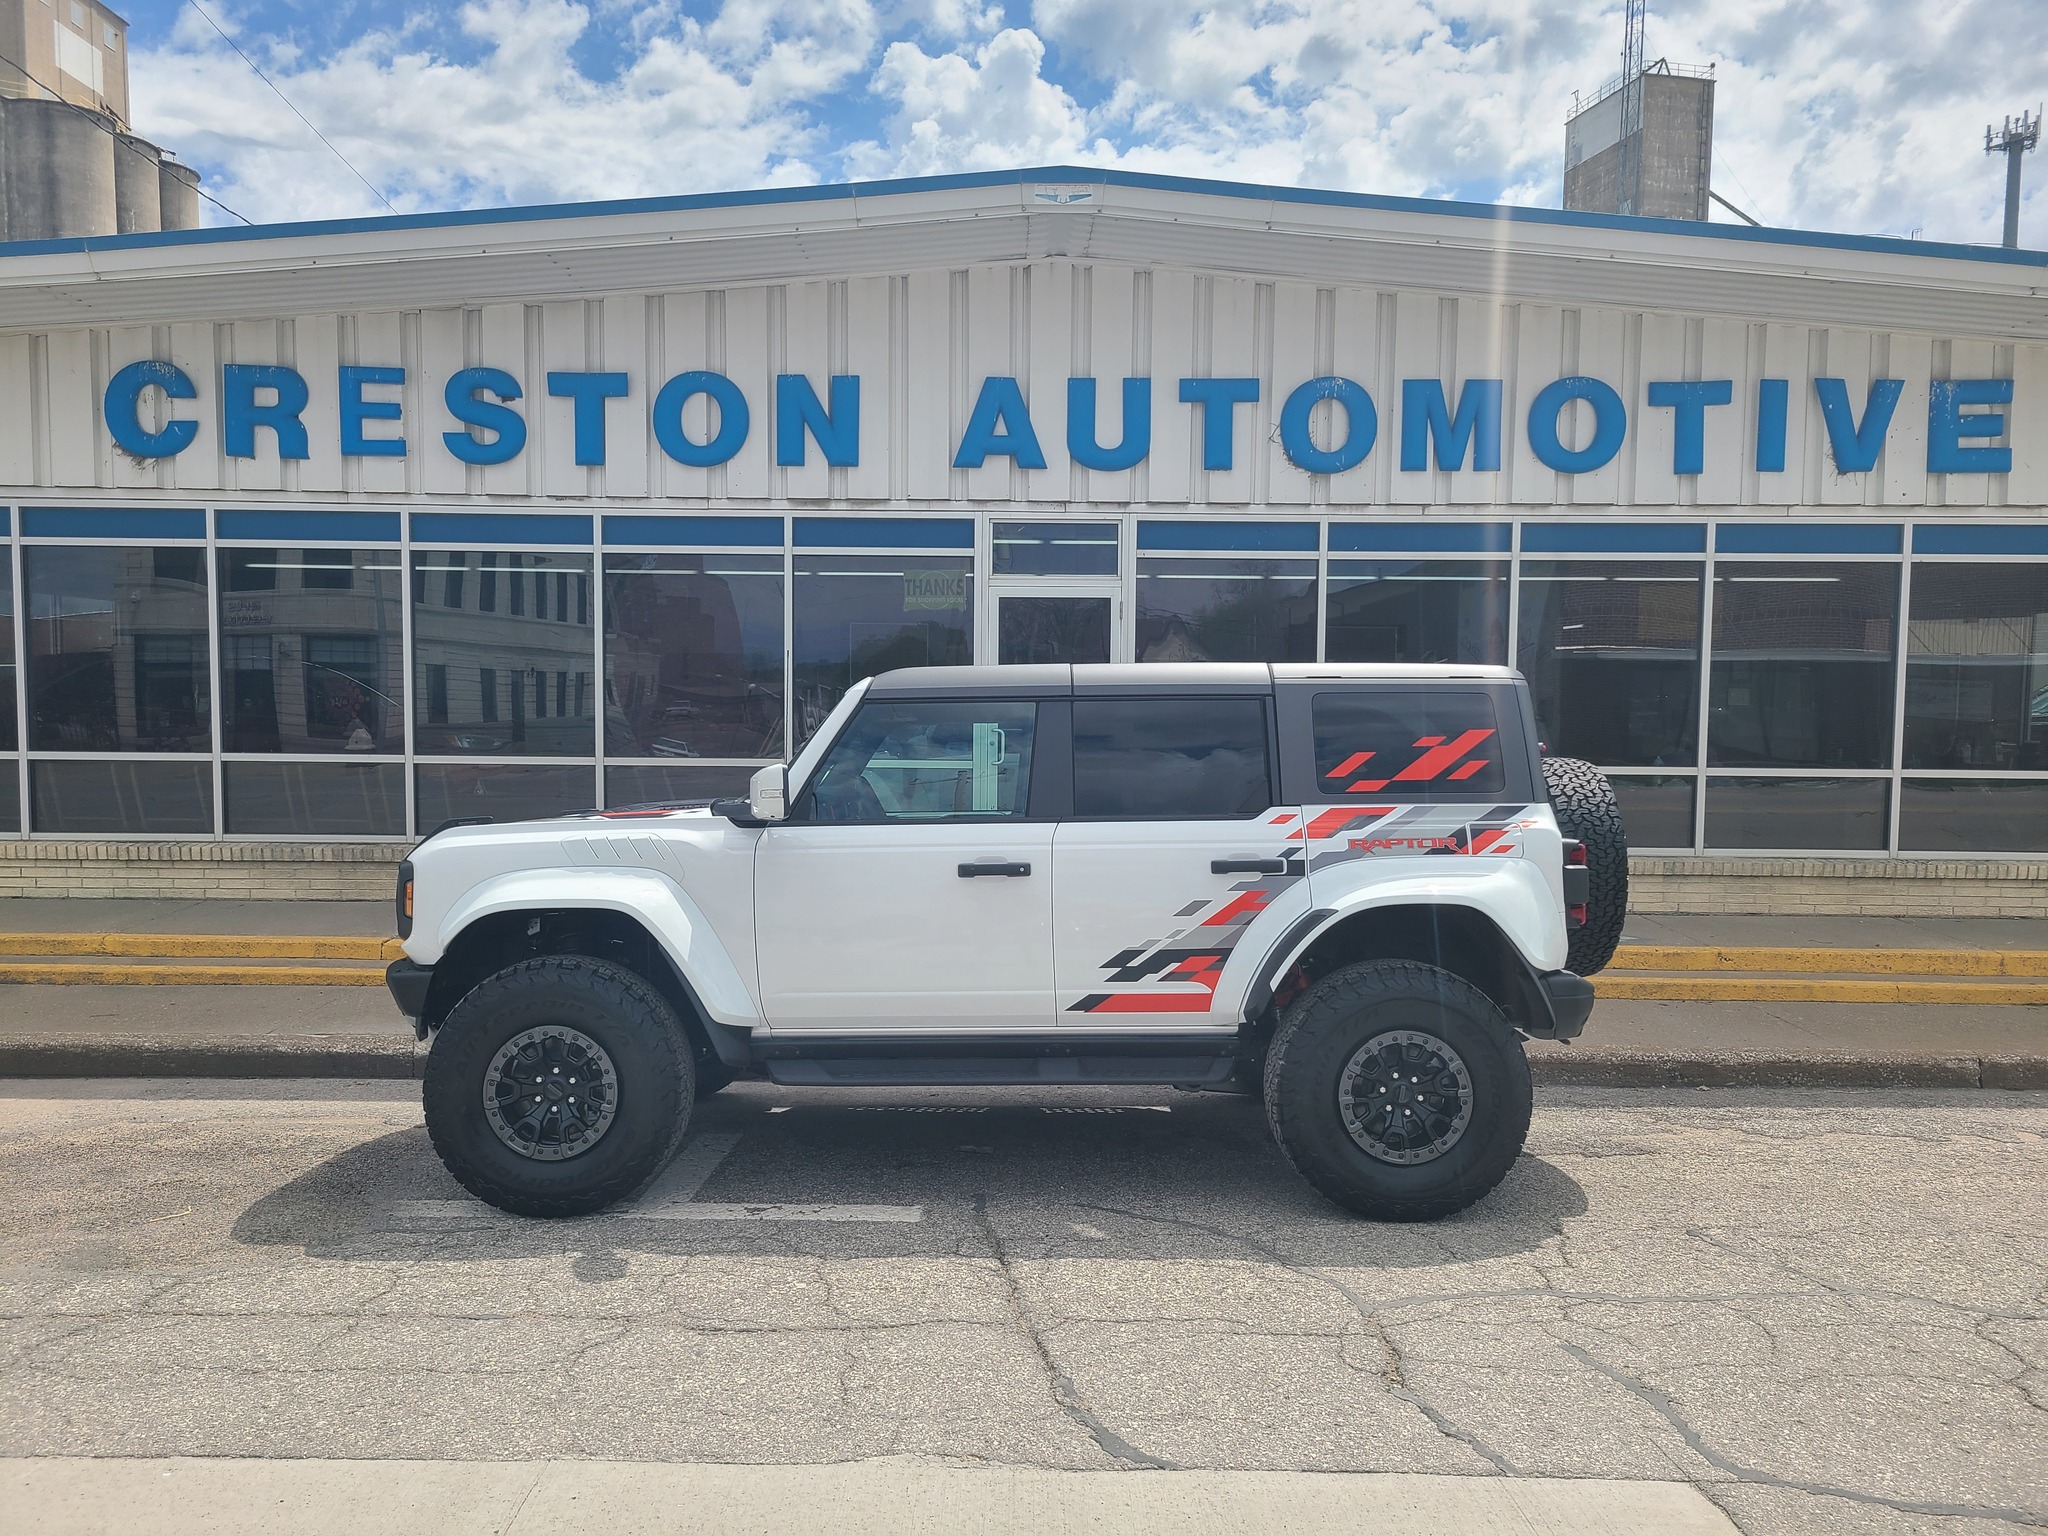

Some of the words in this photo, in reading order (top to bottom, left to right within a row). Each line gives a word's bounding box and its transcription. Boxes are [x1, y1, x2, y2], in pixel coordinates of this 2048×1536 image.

[104, 361, 860, 468] CRESTON
[953, 376, 2014, 474] AUTOMOTIVE
[904, 578, 964, 596] THANKS
[1348, 838, 1462, 854] RAPTOR
